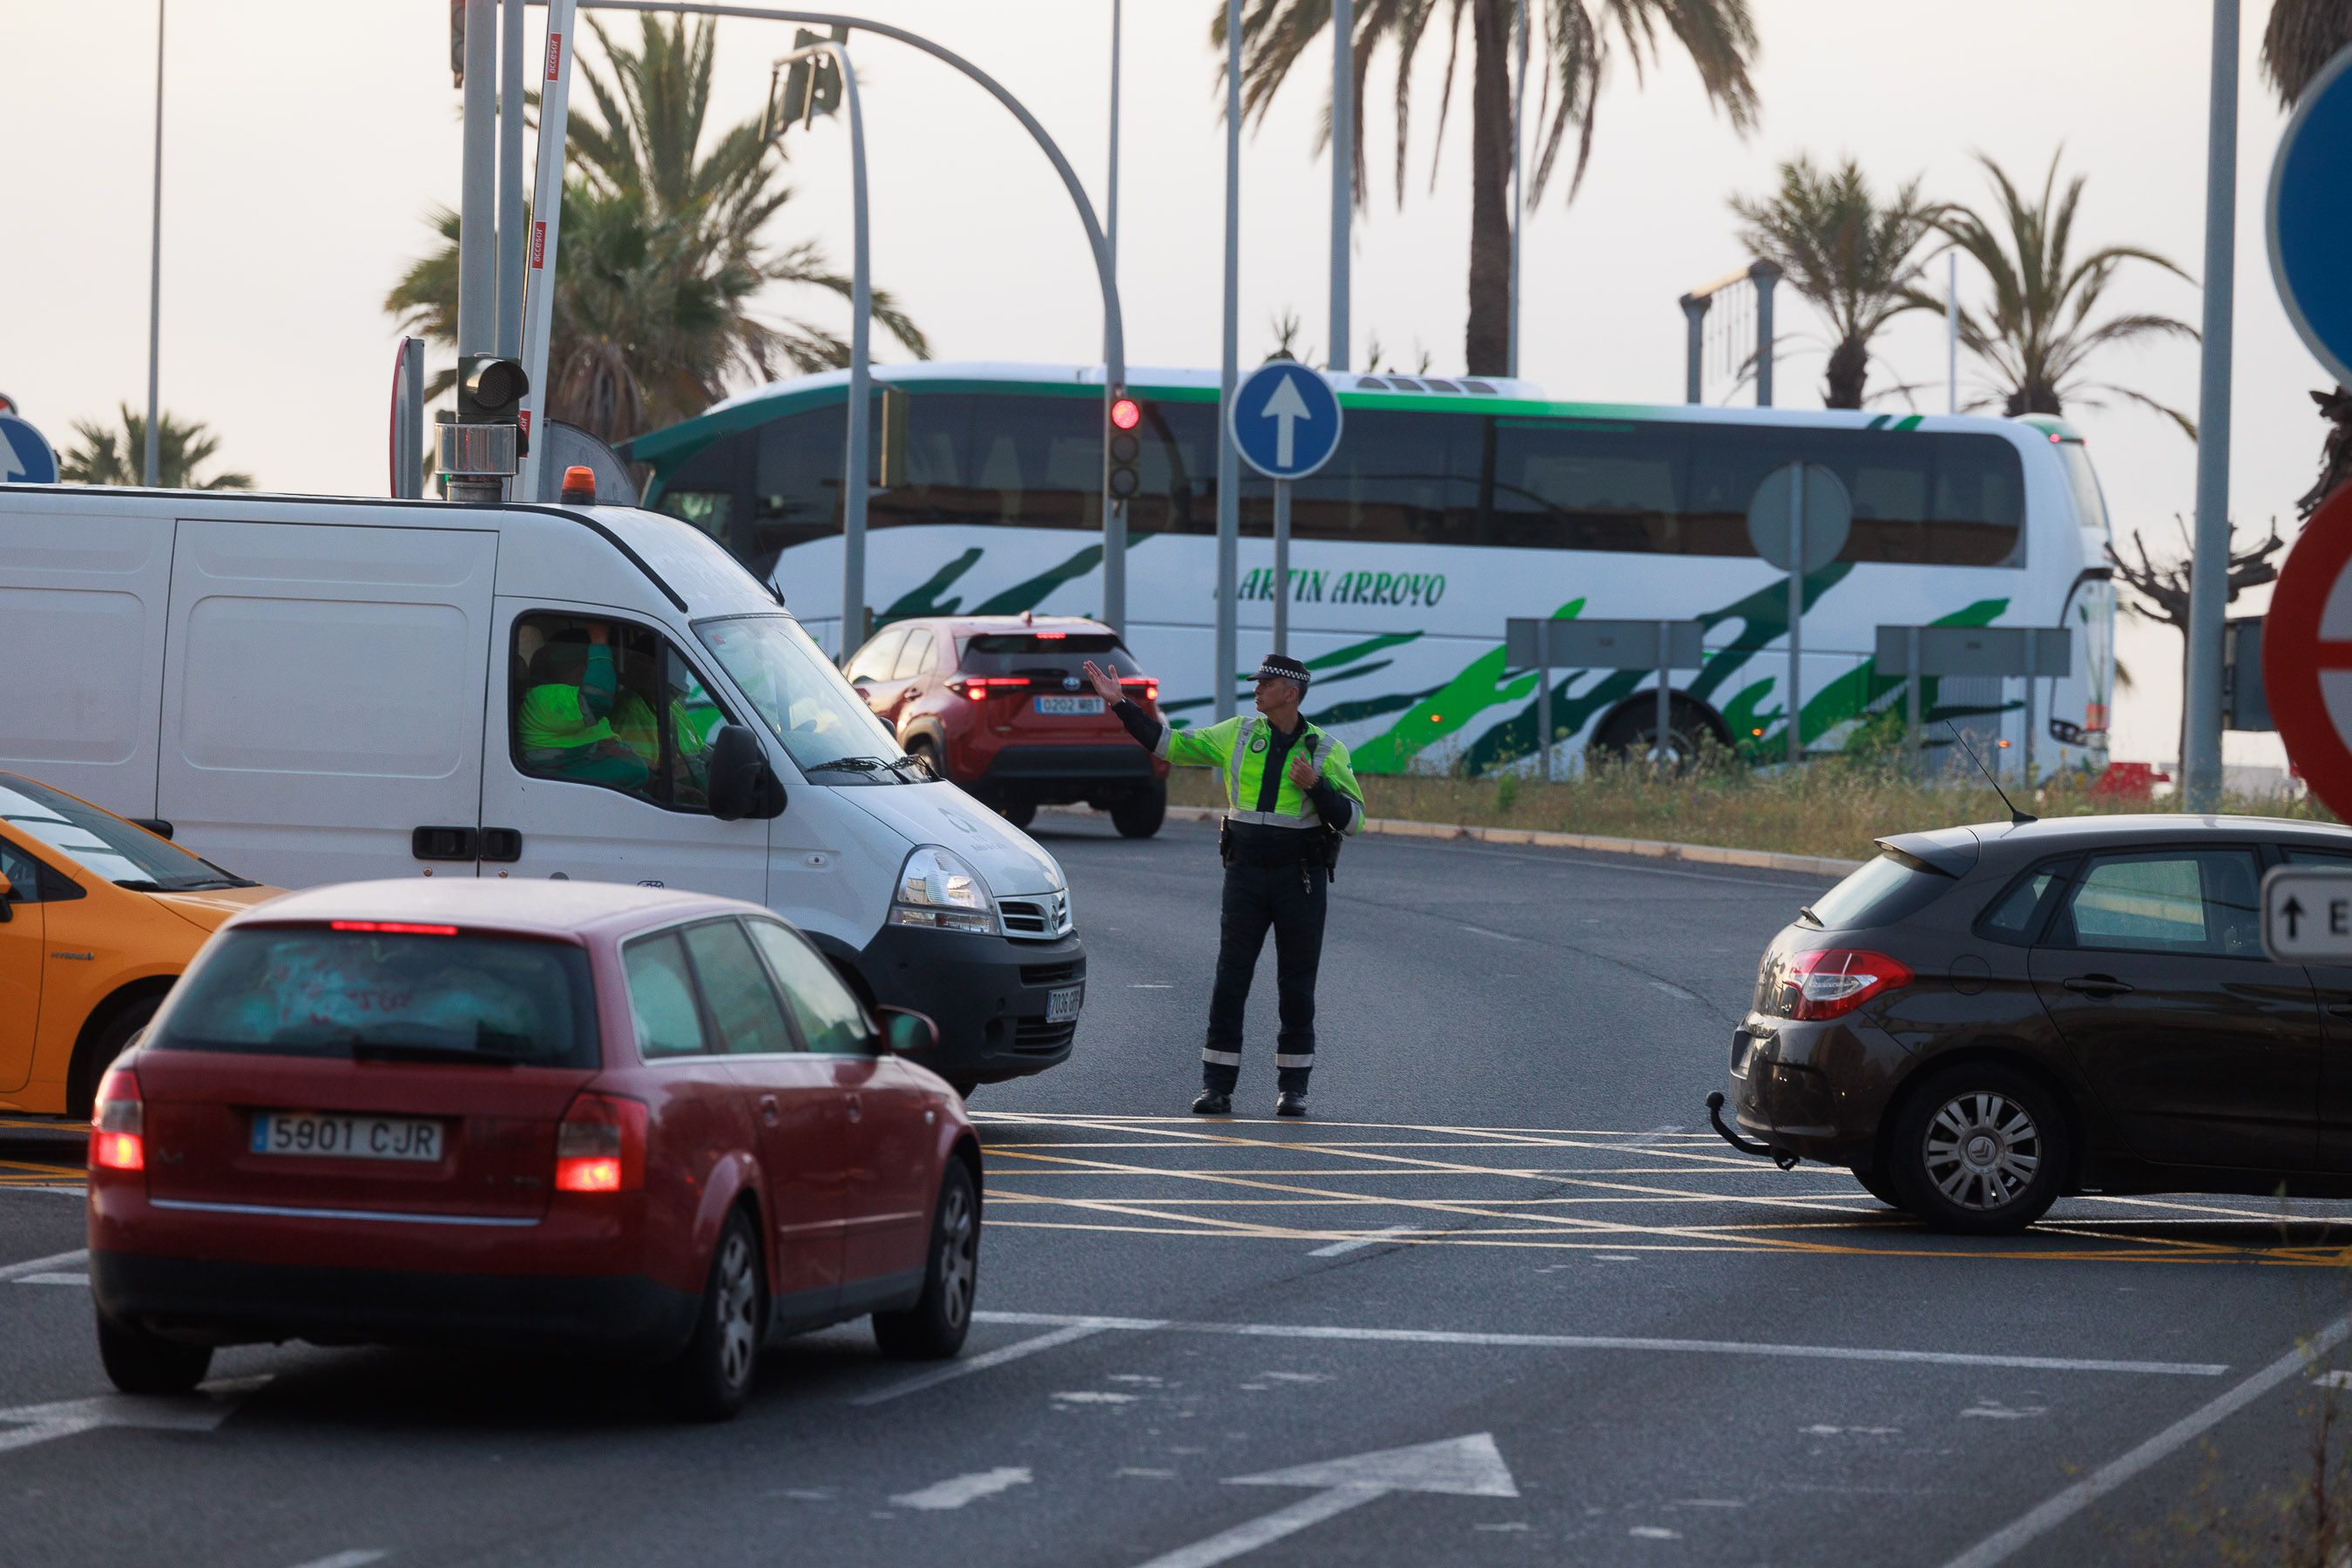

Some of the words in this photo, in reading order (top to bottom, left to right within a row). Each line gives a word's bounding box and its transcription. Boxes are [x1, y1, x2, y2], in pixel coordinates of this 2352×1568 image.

[1331, 571, 1446, 607] ARROYO
[1051, 992, 1068, 1015] 7036
[275, 1119, 353, 1151] 5901
[369, 1123, 435, 1155] CJR
